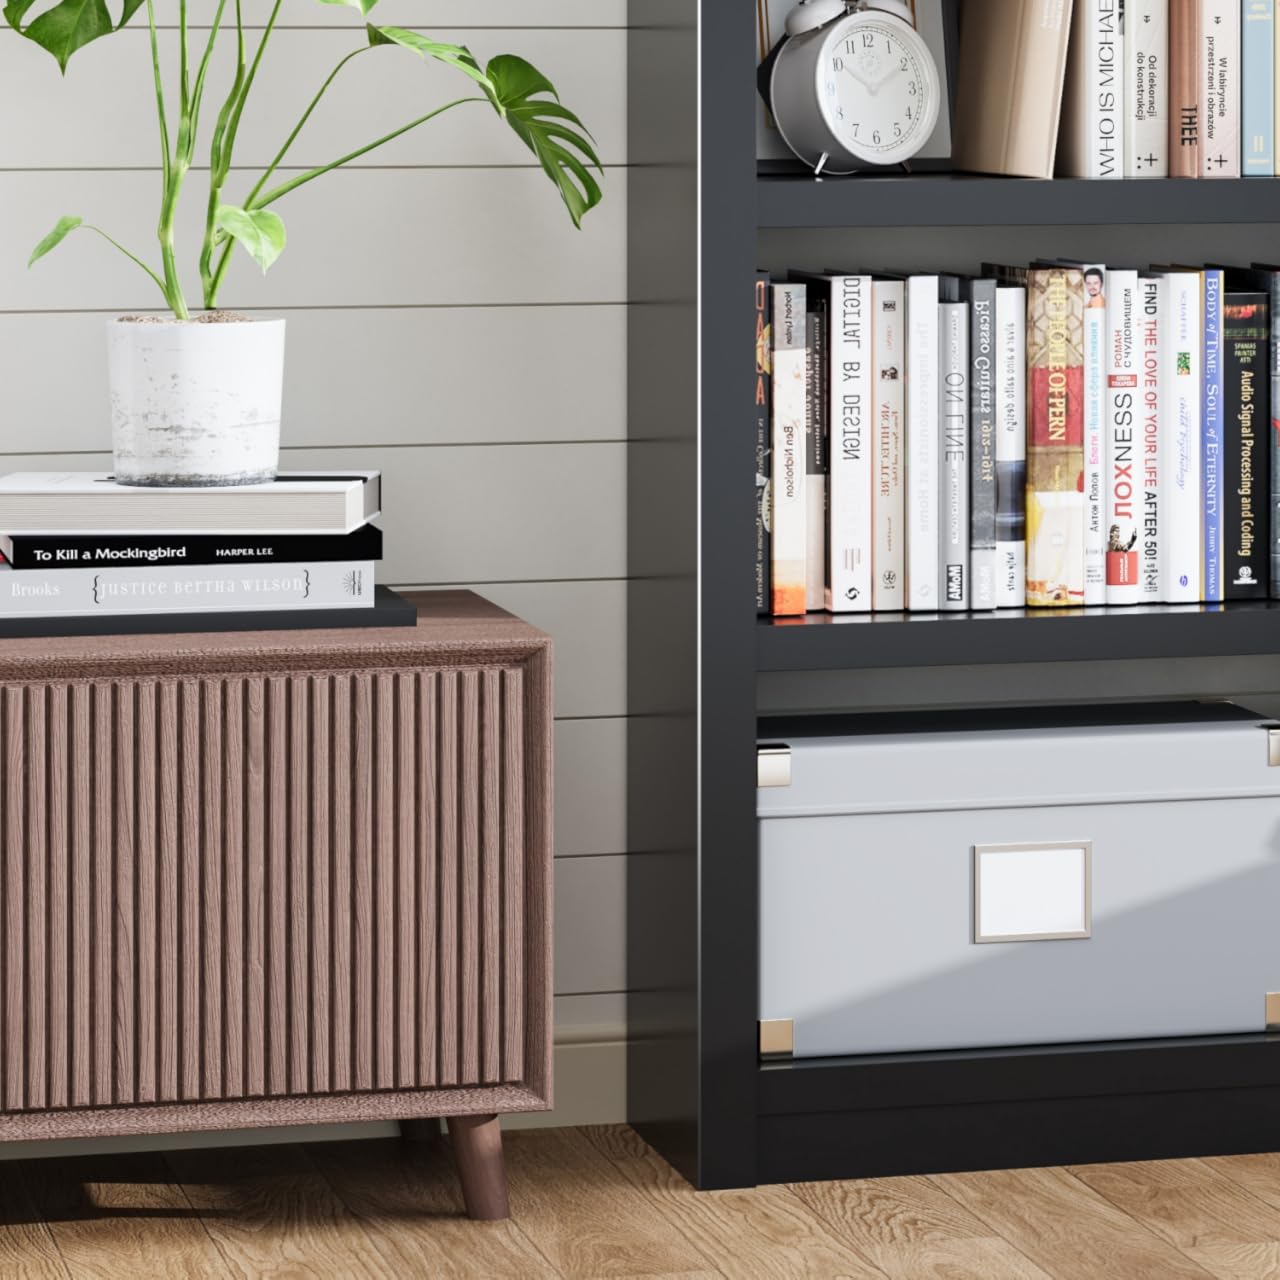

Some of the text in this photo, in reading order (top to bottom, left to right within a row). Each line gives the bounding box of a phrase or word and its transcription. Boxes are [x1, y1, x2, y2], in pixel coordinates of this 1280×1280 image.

[862, 35, 874, 48] 12
[1099, 92, 1114, 111] IS
[1147, 70, 1157, 117] dekoracji
[1217, 68, 1227, 117] labiryncie
[873, 131, 880, 144] 6
[1181, 106, 1197, 146] THEE
[1207, 97, 1215, 139] obrazów
[1099, 117, 1115, 176] WHO
[1124, 289, 1134, 358] ЧУДОВИЩЕМ
[1114, 330, 1124, 367] РОМАН
[1144, 283, 1157, 537] FIND THE LOVE OF YOUR LIFE AFTER
[1206, 277, 1219, 517] BODY of TIME, SOUL ETERNITY
[1114, 393, 1133, 519] ЛОХNESS
[1238, 371, 1253, 557] Audio Signal Processing and Coding
[1089, 473, 1099, 531] Антон Попов
[34, 546, 186, 564] To Kill a Mockingbird
[11, 582, 60, 597] Brooks
